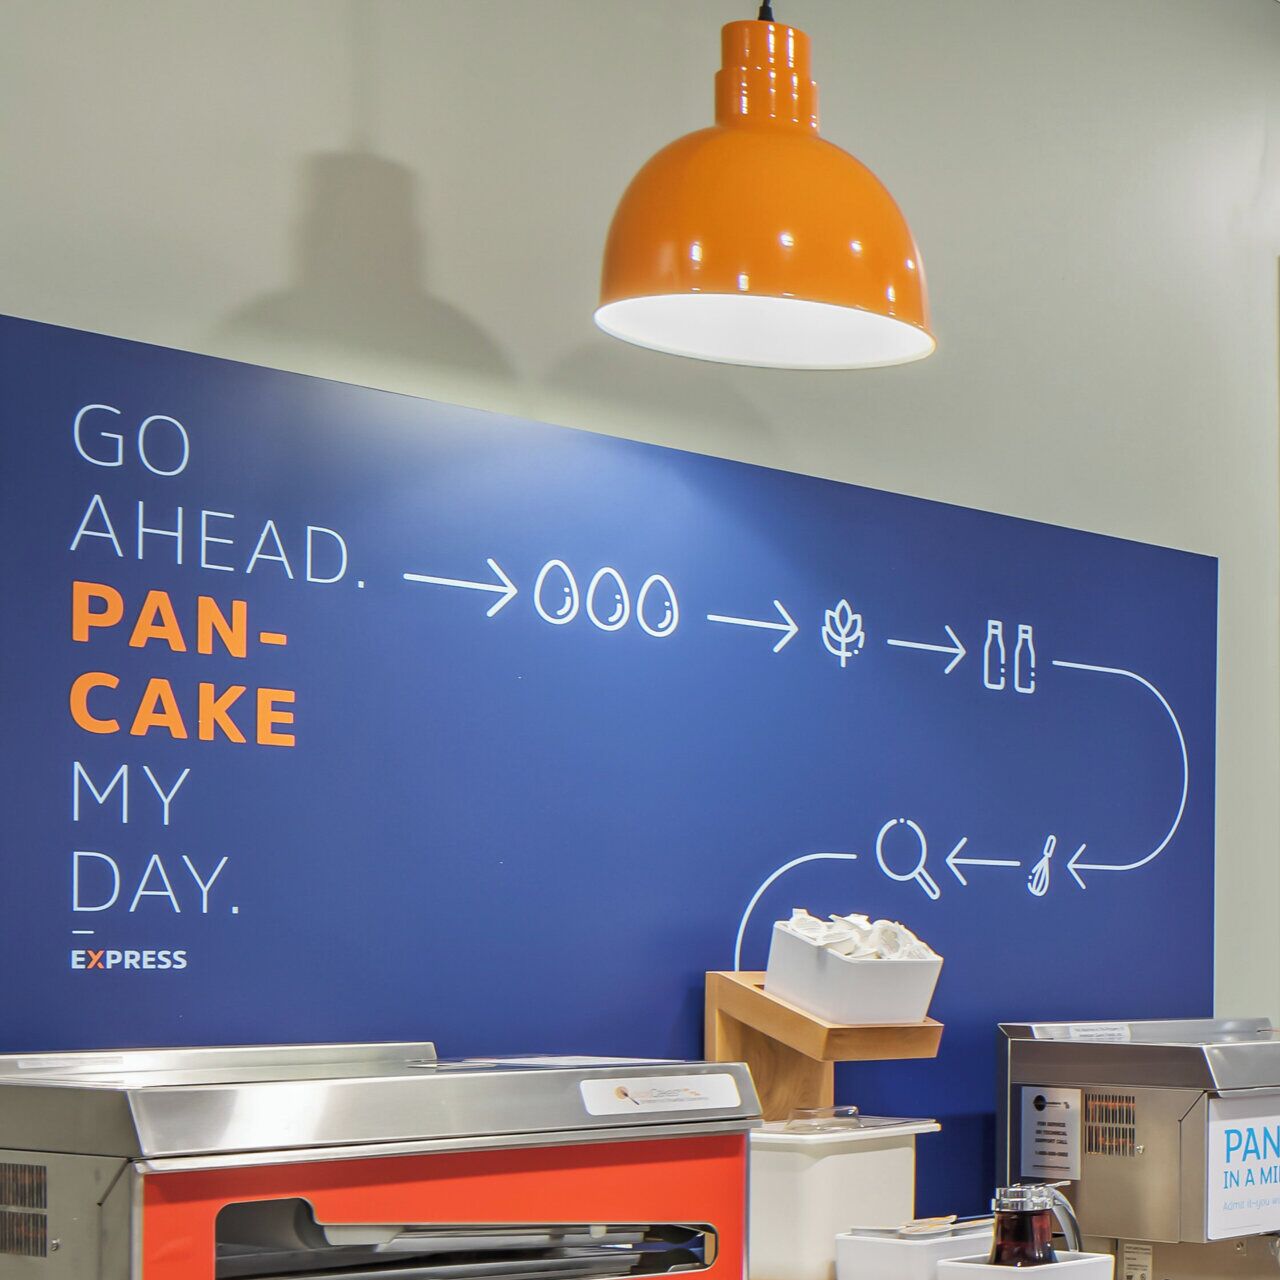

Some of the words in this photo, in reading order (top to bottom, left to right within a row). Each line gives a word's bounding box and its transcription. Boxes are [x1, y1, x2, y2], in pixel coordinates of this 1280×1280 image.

[72, 403, 190, 476] GO
[69, 493, 365, 589] AHEAD.
[71, 581, 288, 660] PAN-
[68, 671, 297, 748] CAKE
[72, 760, 191, 826] MY
[71, 849, 240, 915] DAY.
[70, 948, 188, 970] EXPRESS
[1223, 1169, 1240, 1190] IN
[1245, 1168, 1255, 1187] A
